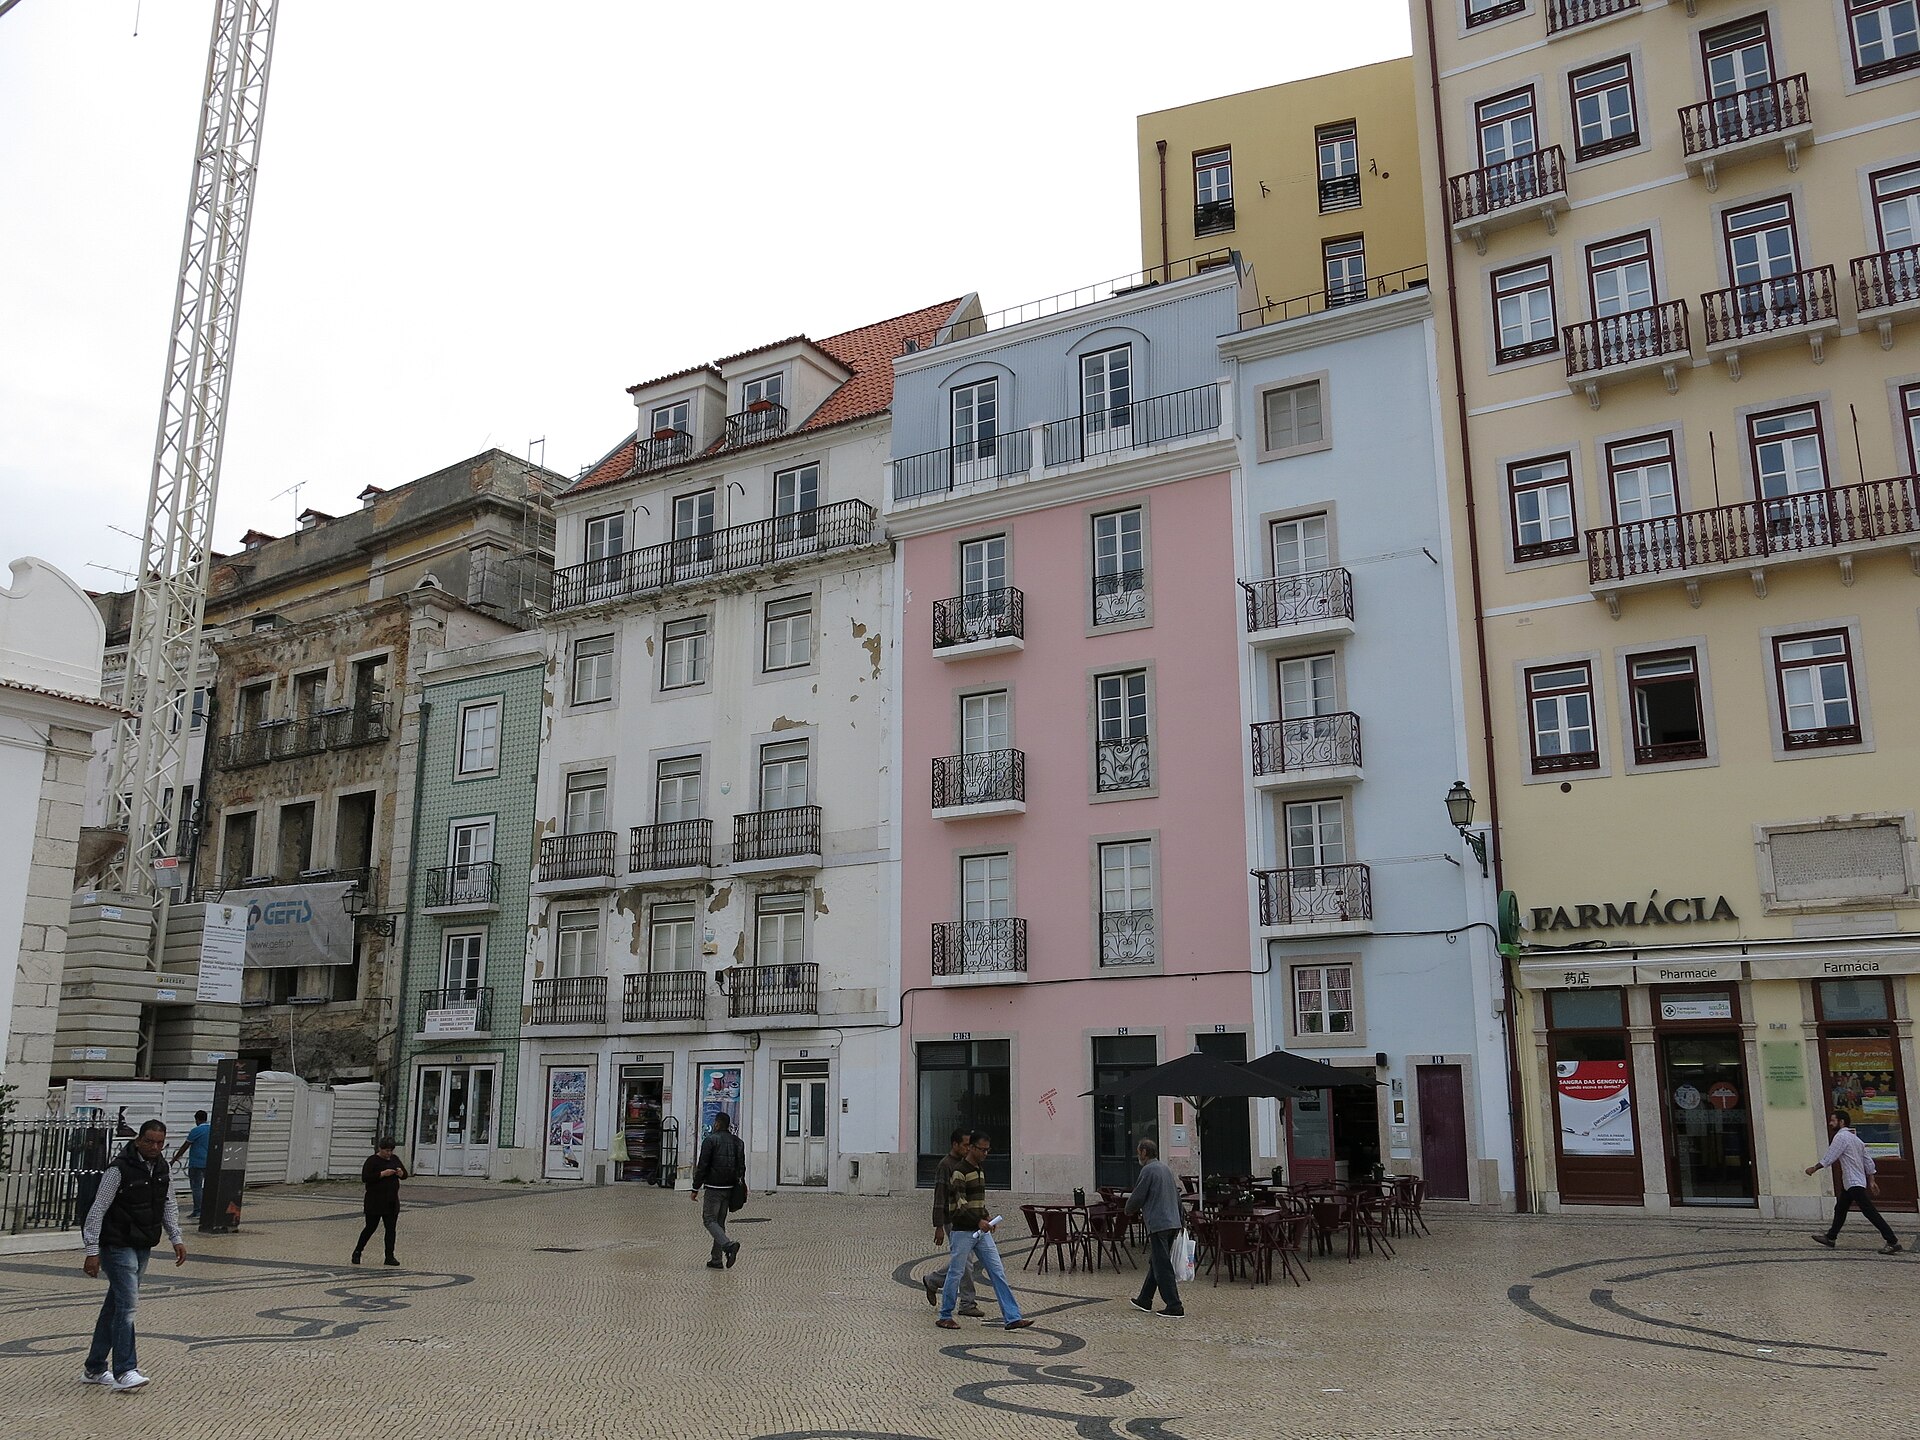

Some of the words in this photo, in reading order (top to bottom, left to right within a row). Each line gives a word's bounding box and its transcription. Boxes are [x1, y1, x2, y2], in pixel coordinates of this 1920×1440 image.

[264, 900, 312, 925] GEFIS
[1530, 889, 1739, 931] FARMÁCIA
[1824, 960, 1879, 973] Farmácia
[1564, 972, 1590, 985] 药店
[1660, 967, 1717, 980] Pharmacie
[1434, 1056, 1442, 1064] 18
